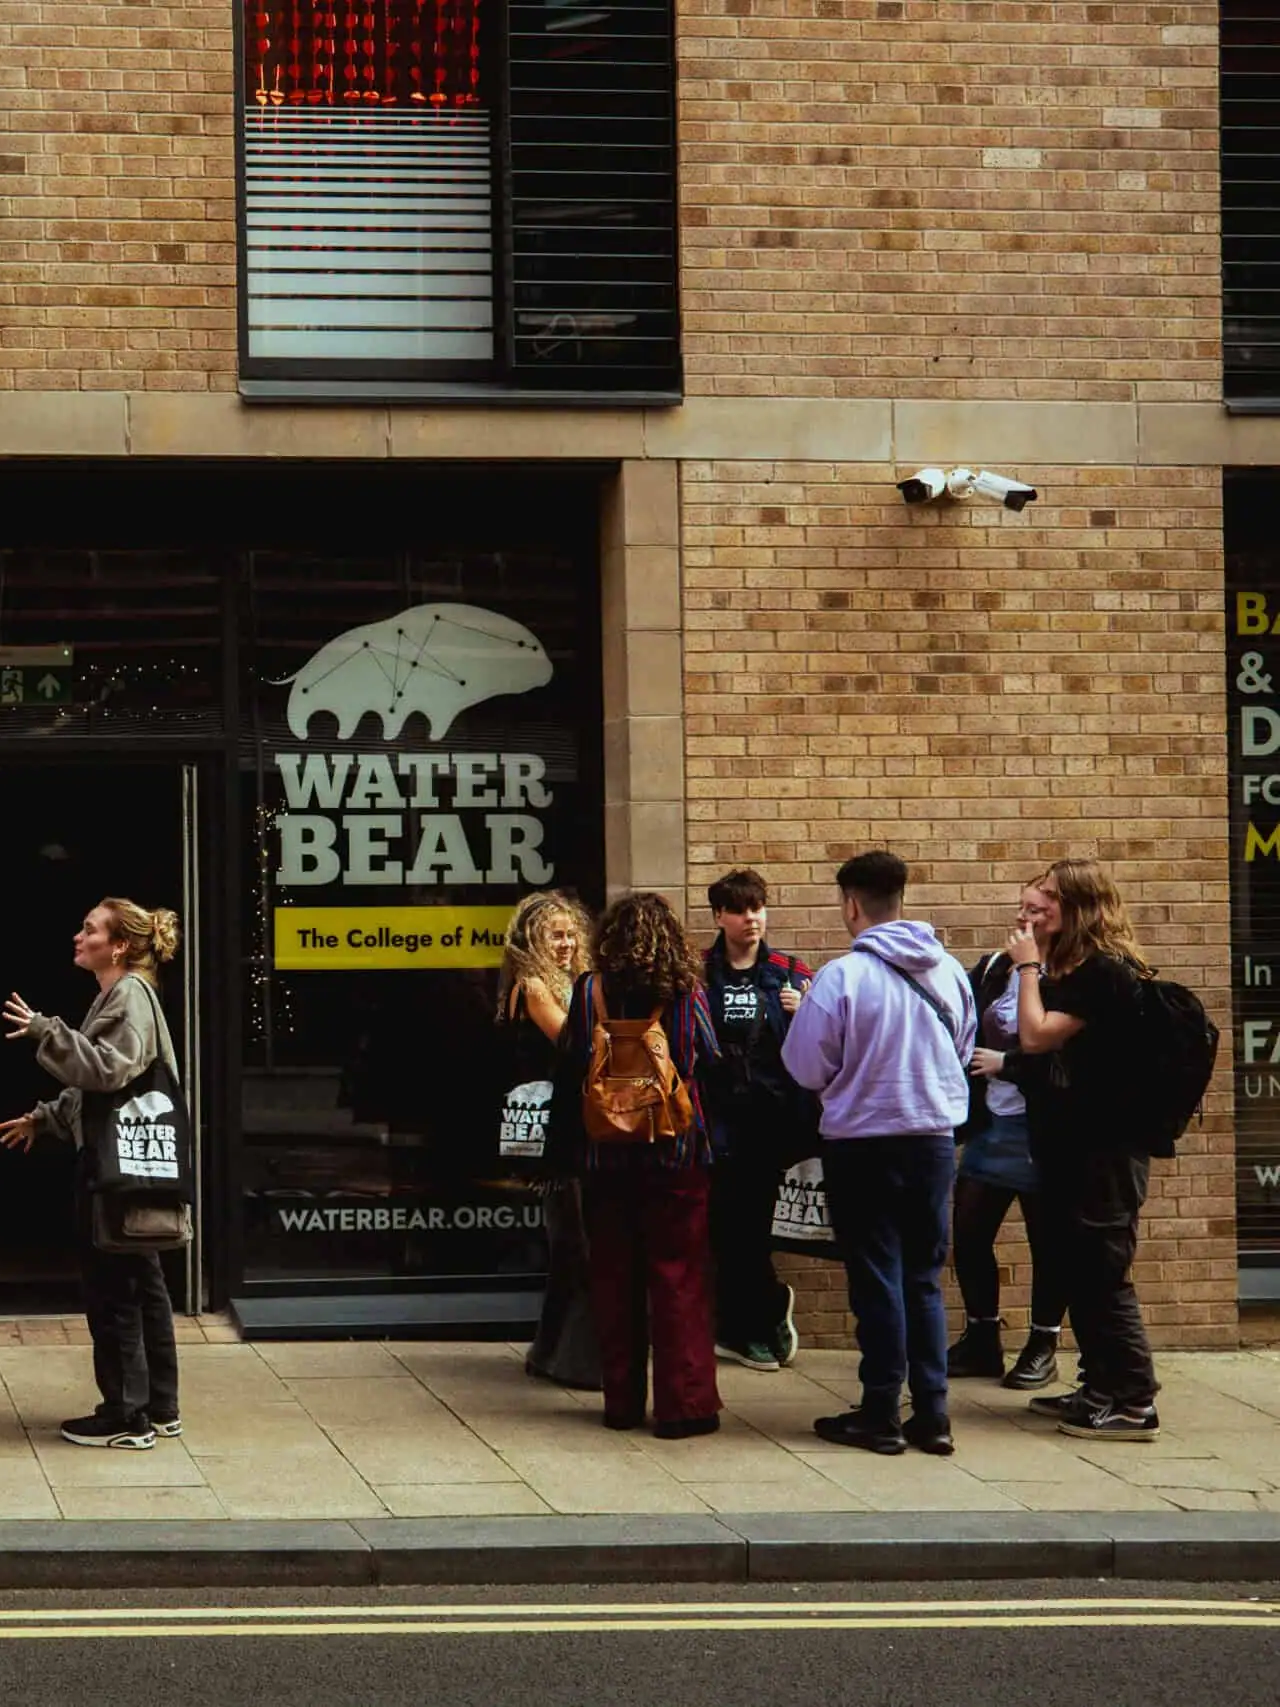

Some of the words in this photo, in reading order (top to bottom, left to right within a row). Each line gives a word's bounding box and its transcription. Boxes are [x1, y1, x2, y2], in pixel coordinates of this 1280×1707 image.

[1236, 591, 1280, 635] B
[1236, 651, 1274, 694] &
[275, 752, 553, 809] WATER
[276, 813, 554, 886] BEAR
[297, 929, 339, 948] The
[346, 927, 433, 952] College
[440, 926, 464, 947] of
[1243, 955, 1273, 986] In
[1243, 1021, 1280, 1064] F
[501, 1107, 552, 1125] WATE
[115, 1123, 177, 1142] WATER
[499, 1122, 547, 1142] BEA
[117, 1139, 178, 1161] BEAR
[778, 1185, 827, 1208] WATE
[279, 1205, 548, 1232] WATERBEAR.ORG.U
[773, 1200, 832, 1226] BEA
